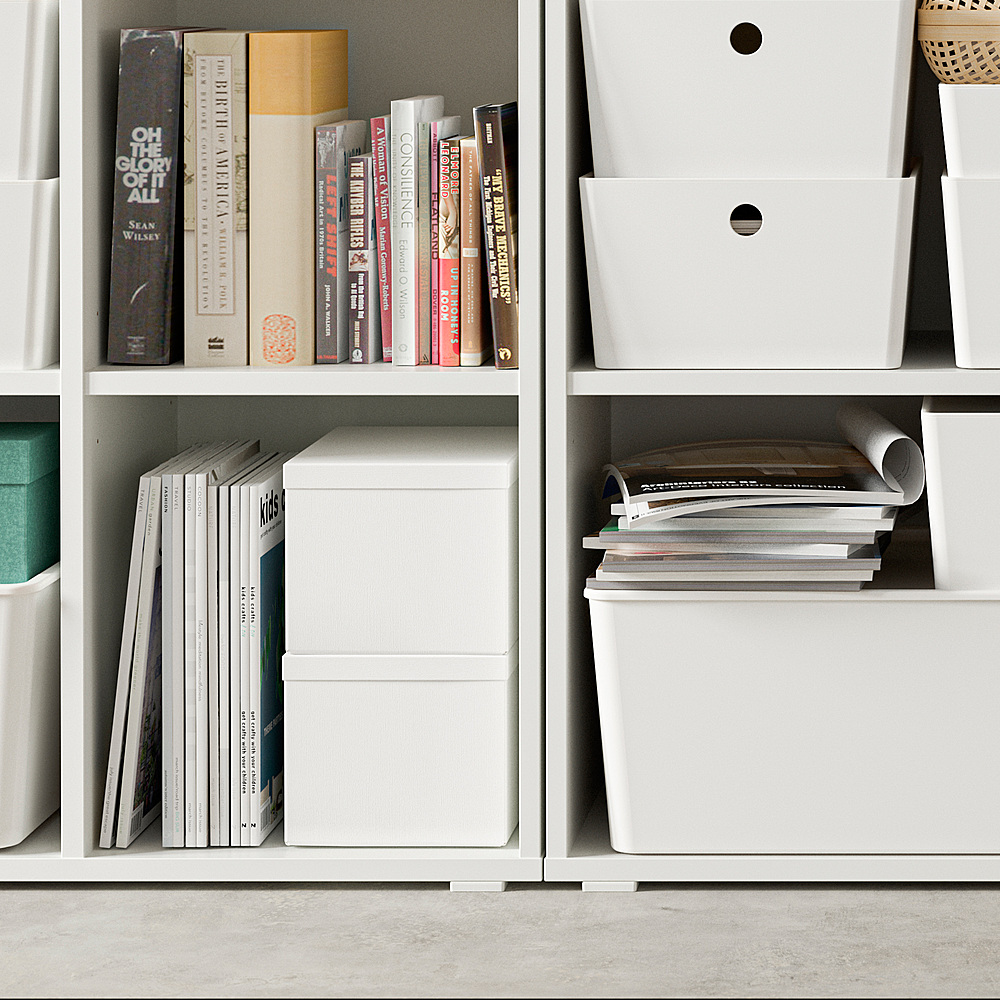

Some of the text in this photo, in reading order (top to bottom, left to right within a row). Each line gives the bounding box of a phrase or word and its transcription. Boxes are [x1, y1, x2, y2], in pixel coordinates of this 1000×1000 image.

[217, 60, 225, 76] THE
[215, 80, 228, 129] BIRTH
[131, 126, 162, 142] OH
[218, 133, 225, 144] OF
[129, 142, 162, 158] THE
[116, 156, 172, 173] GLORY
[350, 161, 365, 178] THE
[440, 141, 450, 199] LEONARD
[450, 146, 459, 195] ELMORE
[122, 172, 167, 188] OF IT
[216, 148, 229, 218] AMERICA
[400, 132, 413, 229] CONSILIENCE
[483, 176, 491, 186] The
[127, 188, 160, 204] ALL
[350, 180, 365, 216] KHYBER
[468, 193, 473, 202] OF
[484, 187, 492, 200] First
[202, 199, 208, 211] TO
[484, 202, 494, 223] Michigan
[493, 196, 507, 233] BRAVE
[128, 220, 156, 230] SEAN
[326, 175, 337, 277] LEFT SHIFT
[376, 127, 390, 311] A Woman of Vision Marian Goronwy-Roberts
[122, 230, 161, 241] WILSEY
[350, 218, 365, 248] RIFLES
[486, 225, 495, 248] Engineers
[219, 228, 227, 268] WILLIAM
[398, 239, 408, 273] Edward
[450, 267, 459, 281] UP
[491, 275, 499, 288] Civil
[219, 285, 227, 309] POLK
[450, 285, 459, 295] IN
[398, 288, 408, 319] Wilson
[440, 289, 449, 321] ROOM
[450, 299, 459, 344] HONEY'S
[260, 489, 279, 527] kids
